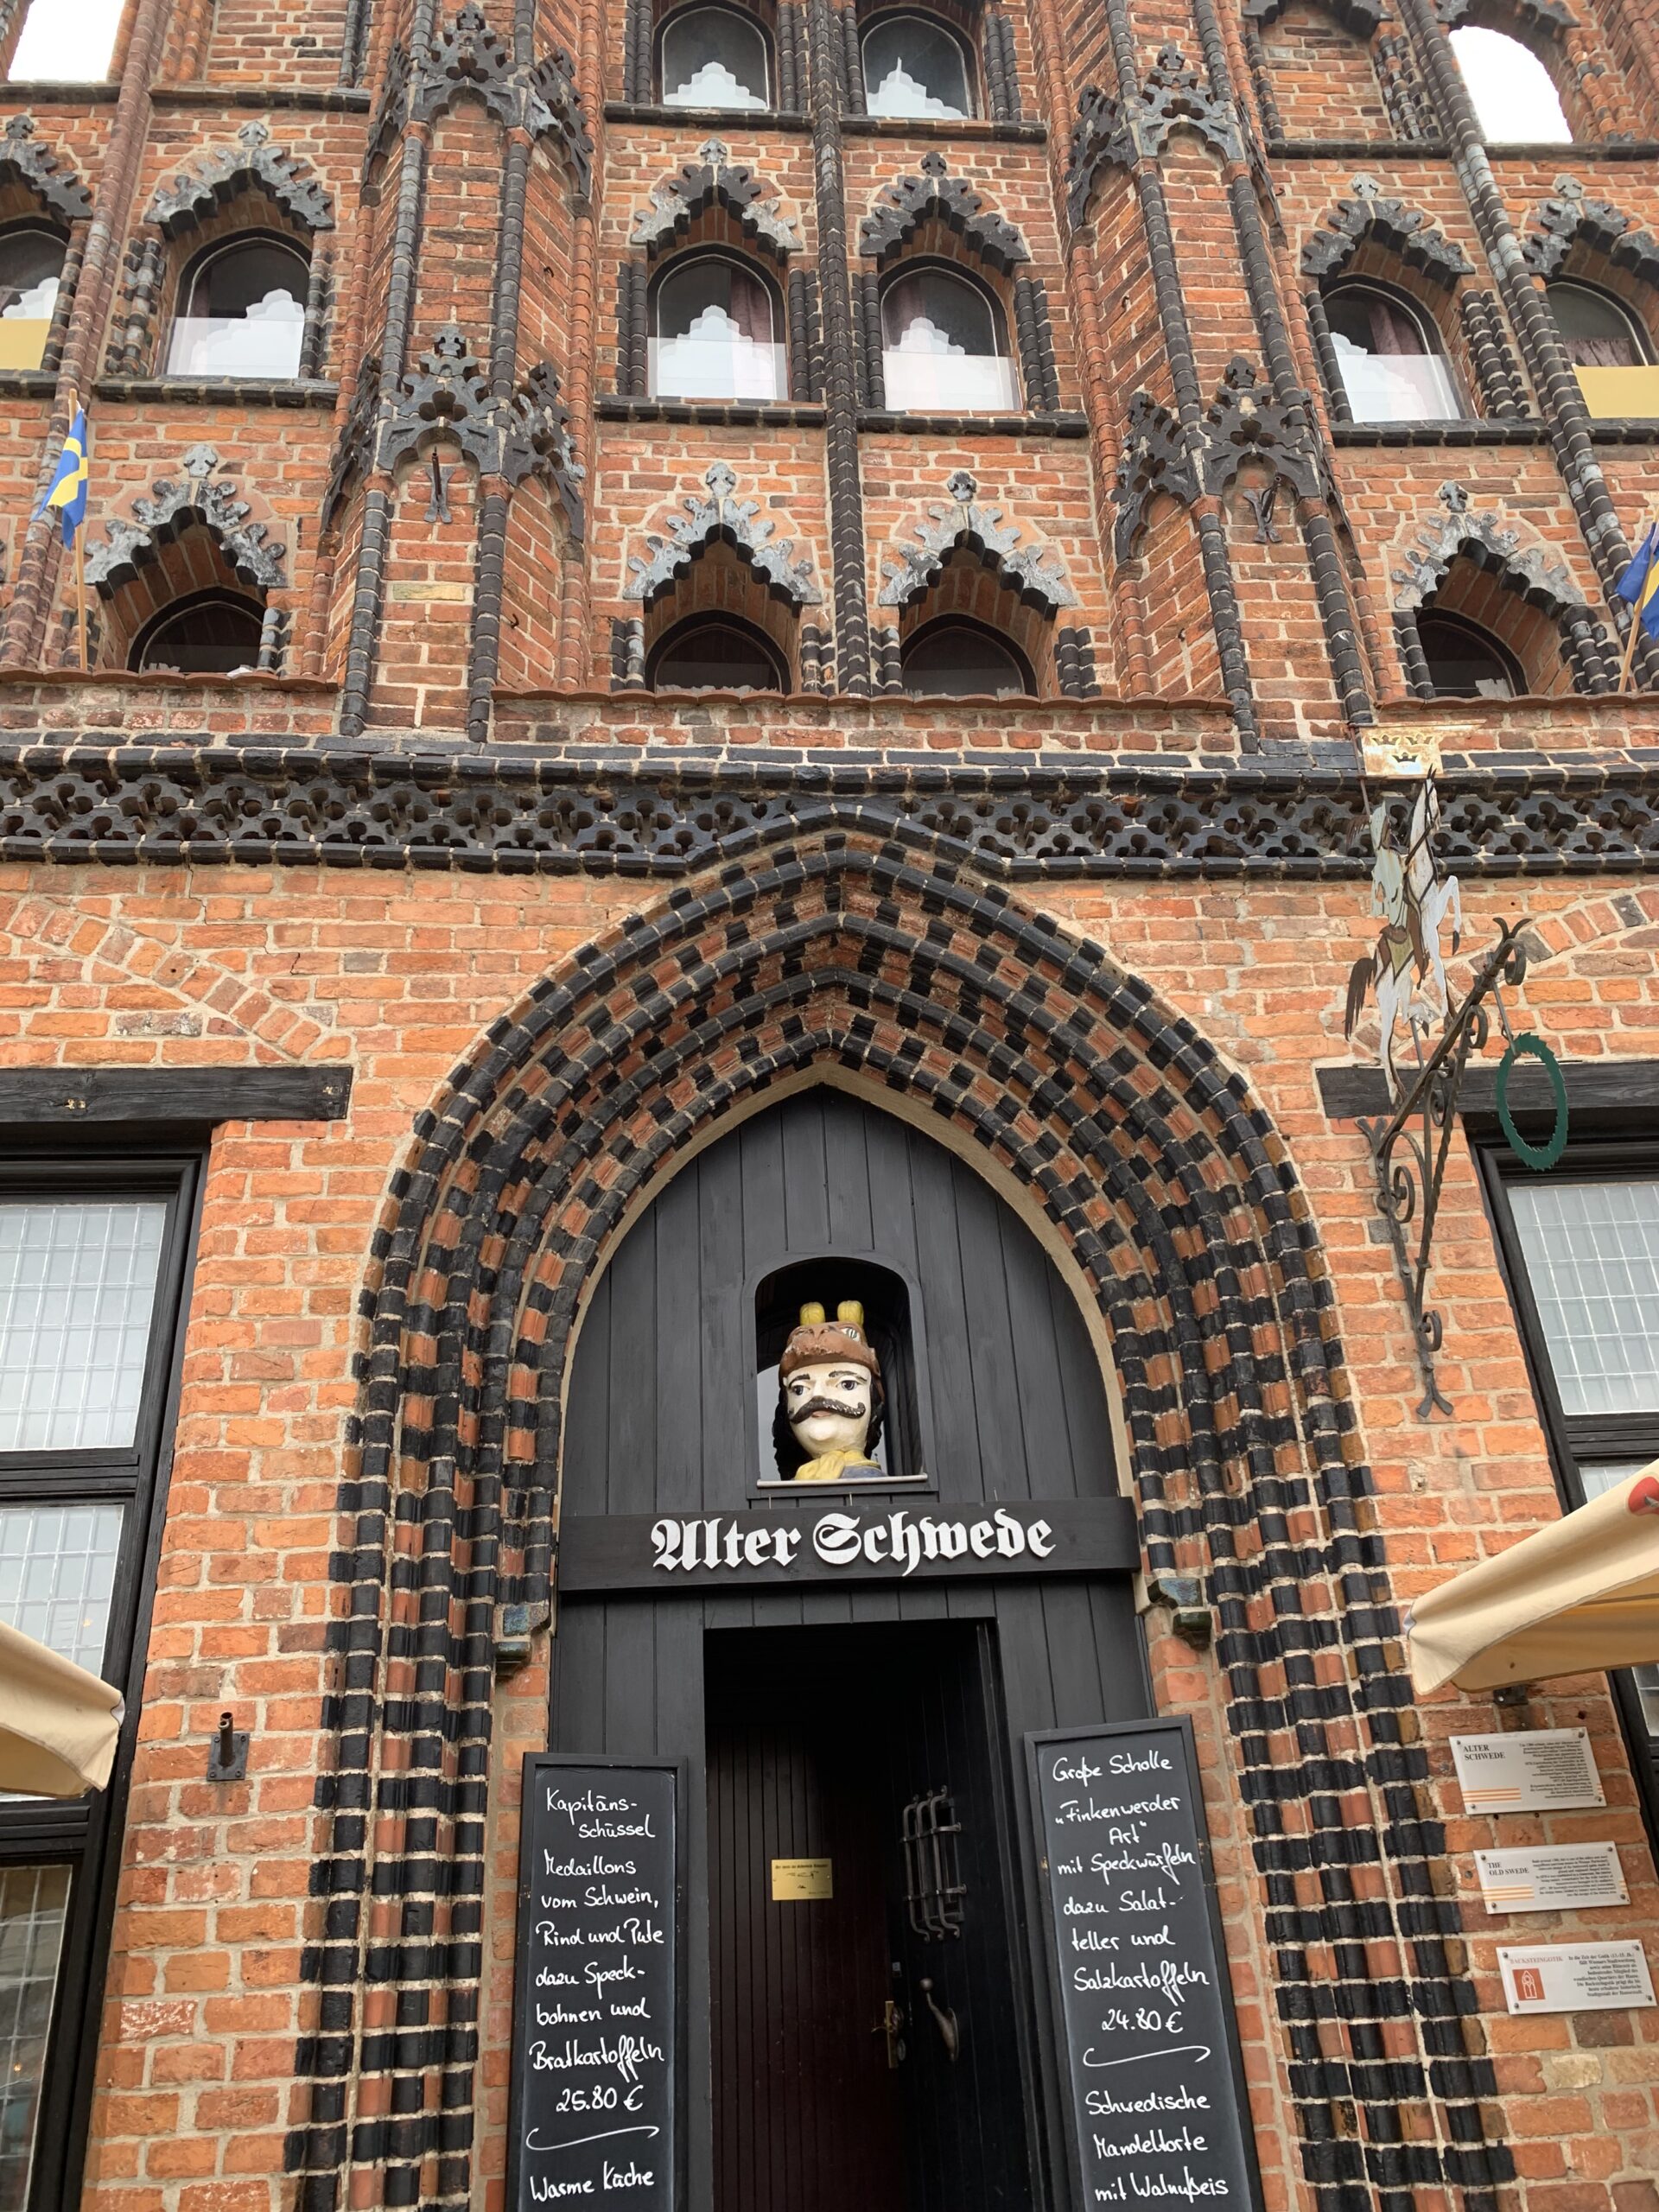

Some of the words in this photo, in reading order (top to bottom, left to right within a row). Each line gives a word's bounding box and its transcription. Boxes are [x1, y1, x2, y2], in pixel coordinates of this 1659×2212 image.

[651, 1517, 802, 1571] Alter
[812, 1509, 1056, 1577] Schwede
[1464, 1744, 1490, 1752] ALTER
[1464, 1751, 1506, 1760] SCHWEDE
[1052, 1757, 1103, 1787] Große
[1109, 1750, 1173, 1774] Scholle
[547, 1787, 638, 1825] Kapitäns-
[578, 1814, 656, 1838] schüssel
[543, 1848, 637, 1876] Medaillons
[1058, 1856, 1083, 1875] mit
[1090, 1842, 1196, 1885] Speckwürfeln
[541, 1895, 577, 1908] vom
[584, 1885, 658, 1908] Schwein,
[1064, 1897, 1109, 1916] dazu
[1119, 1887, 1177, 1911] Salat-
[536, 1921, 585, 1946] Rind
[588, 1926, 625, 1943] und
[623, 1917, 664, 1944] Pute
[1071, 1928, 1120, 1952] teller
[1131, 1925, 1176, 1946] und
[536, 1967, 580, 1986] dazu
[584, 1955, 645, 2000] Speck-
[1074, 1960, 1210, 2006] Salzkartoffeln
[536, 2003, 602, 2025] bohnen
[610, 1997, 651, 2018] und
[1102, 2007, 1161, 2031] 24.80
[1166, 2012, 1183, 2033] €
[529, 2035, 664, 2082] Bratkartoffeln
[556, 2085, 617, 2112] 25.80
[623, 2084, 644, 2111] €
[1085, 2085, 1211, 2115] Schwedische
[1093, 2126, 1208, 2159] Mandeltorte
[530, 2176, 594, 2202] Warme
[603, 2161, 655, 2190] Küche
[1095, 2177, 1127, 2201] mit
[1129, 2165, 1229, 2203] Walnußeis
